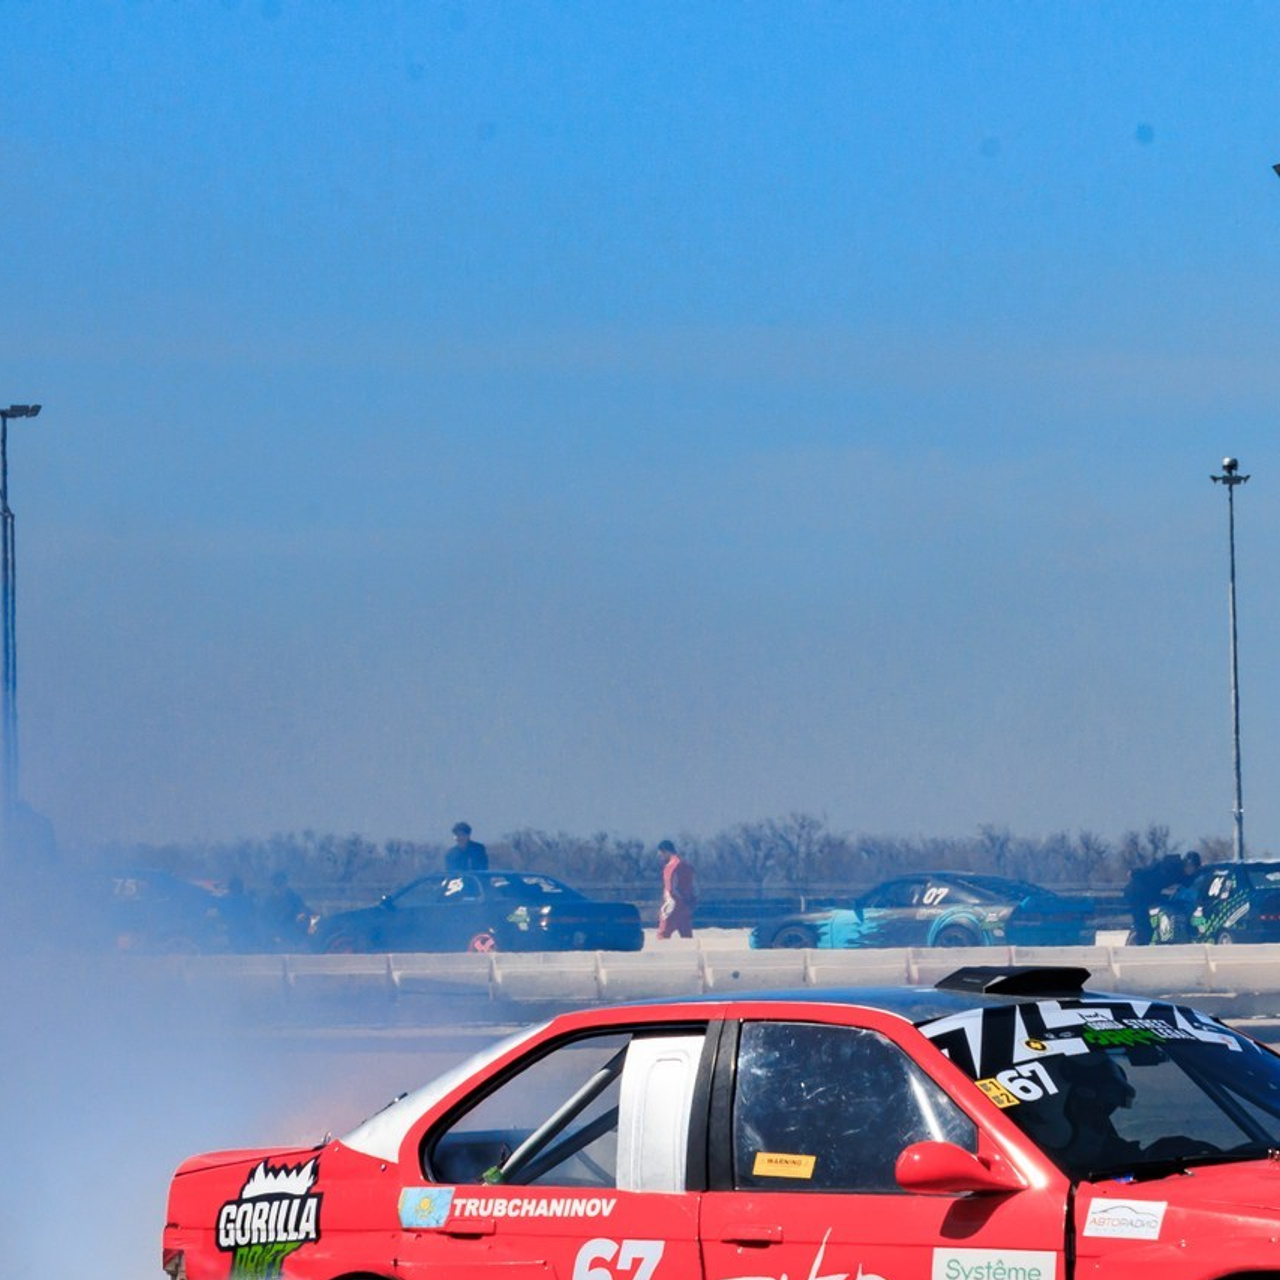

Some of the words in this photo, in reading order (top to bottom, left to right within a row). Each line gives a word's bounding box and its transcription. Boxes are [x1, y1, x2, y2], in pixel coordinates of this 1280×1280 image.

[923, 887, 949, 905] 07
[996, 1061, 1059, 1102] 67
[218, 1198, 319, 1248] GORILLA
[454, 1198, 617, 1218] TRUBCHANINOV
